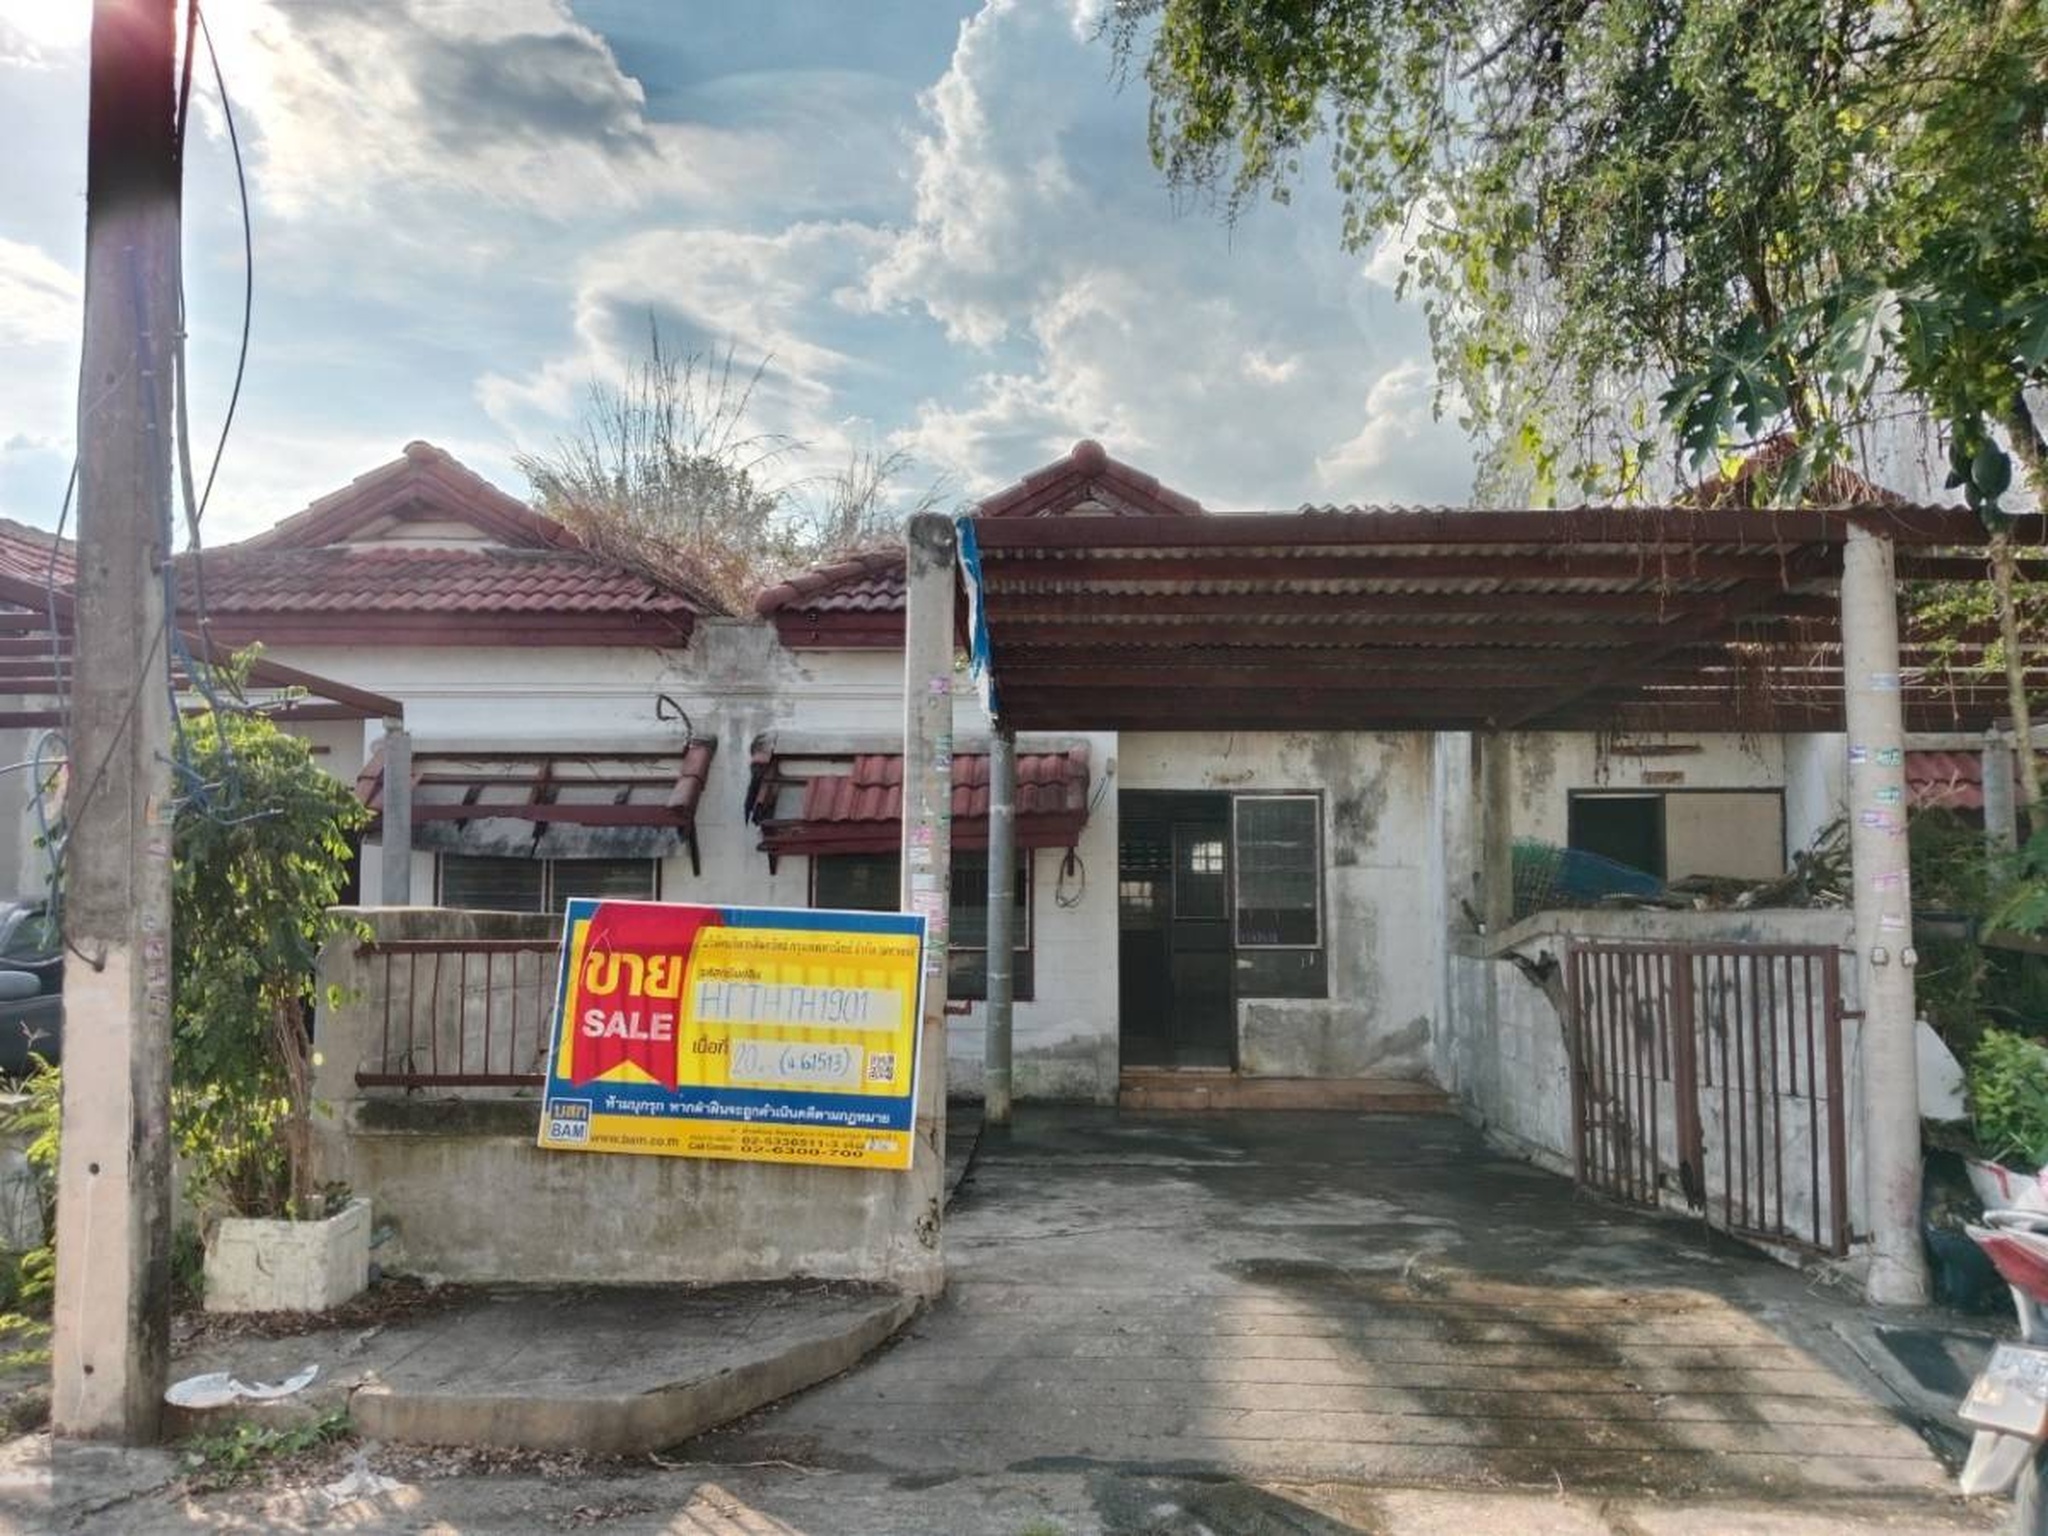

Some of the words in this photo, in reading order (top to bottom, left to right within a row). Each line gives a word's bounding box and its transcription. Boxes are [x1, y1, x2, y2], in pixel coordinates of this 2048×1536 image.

[585, 951, 683, 998] ขาย
[582, 1008, 674, 1041] SALE
[551, 1121, 586, 1139] BAM
